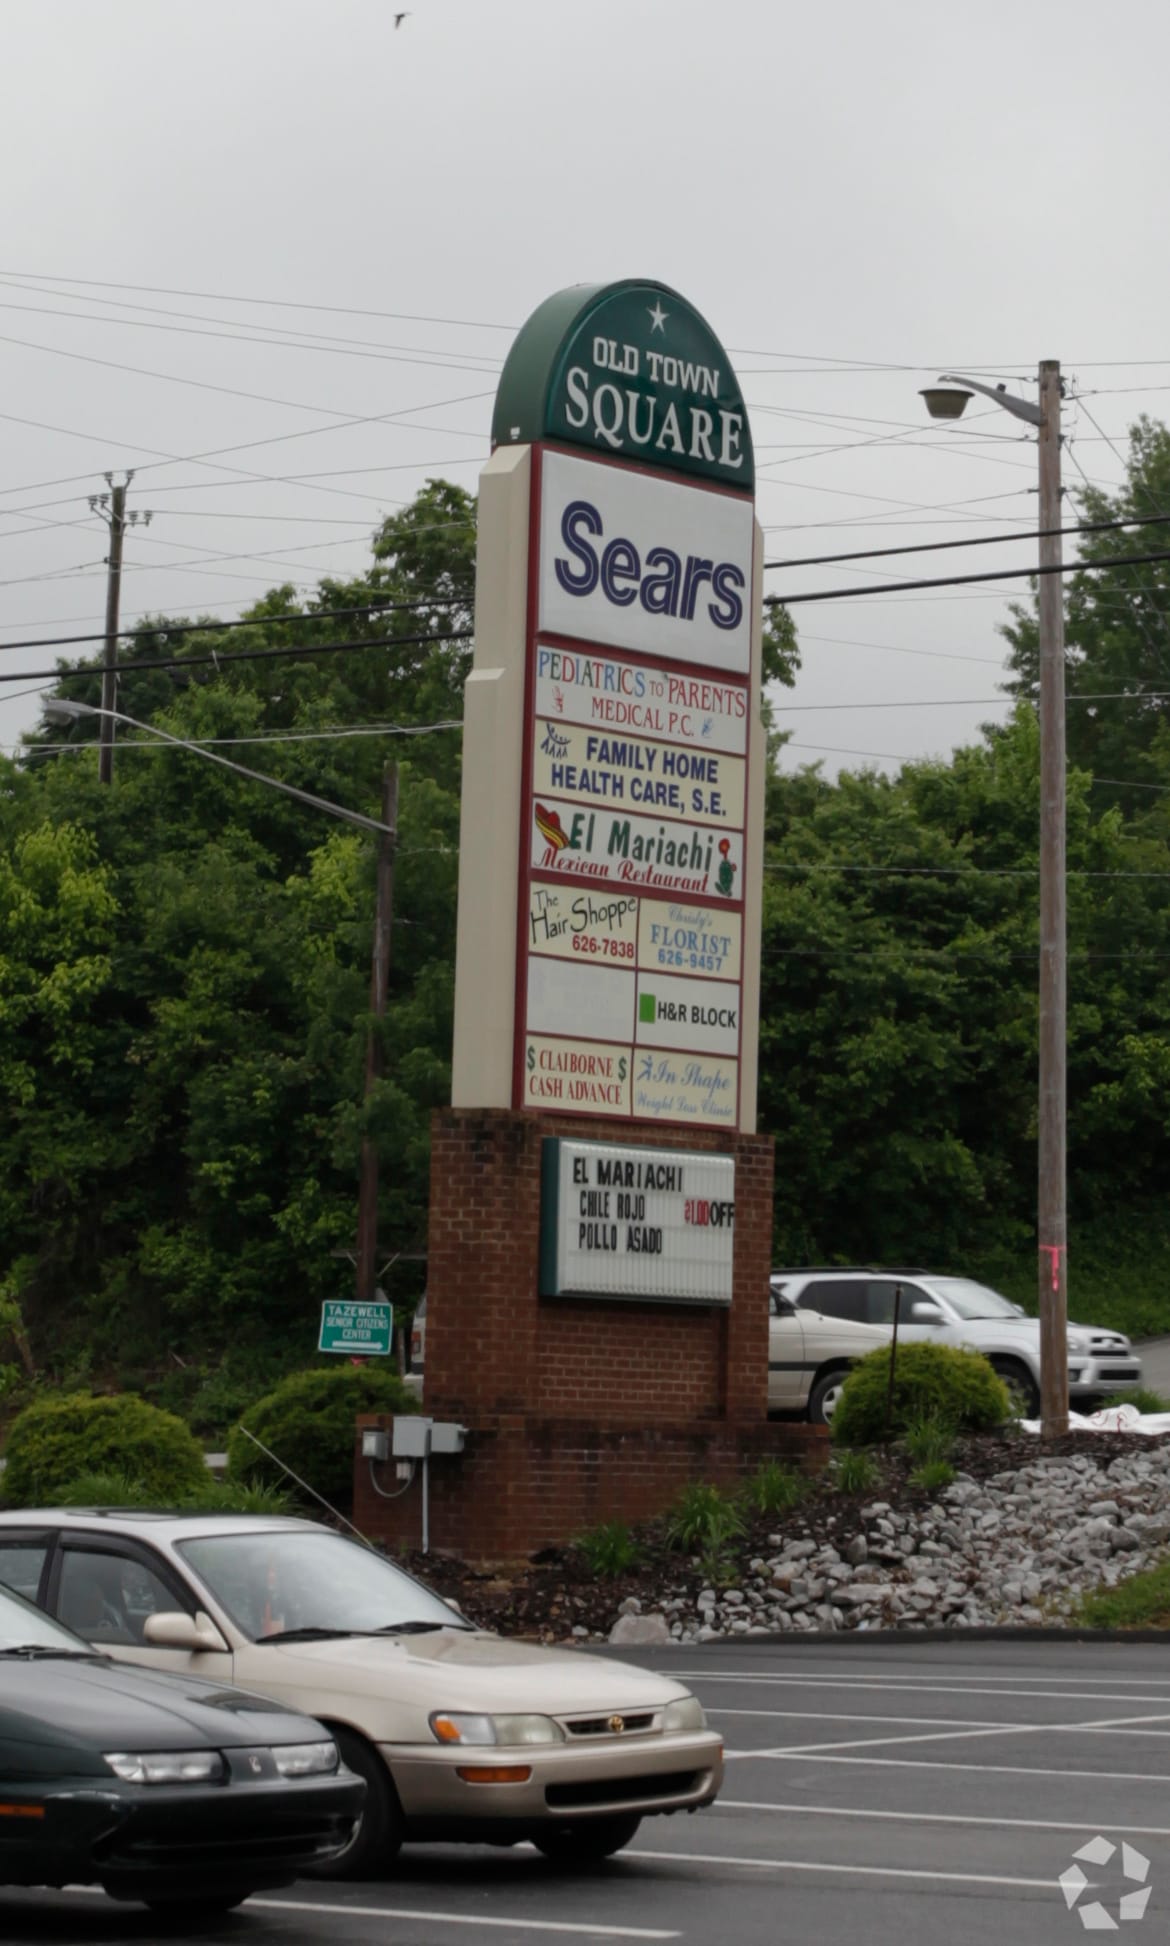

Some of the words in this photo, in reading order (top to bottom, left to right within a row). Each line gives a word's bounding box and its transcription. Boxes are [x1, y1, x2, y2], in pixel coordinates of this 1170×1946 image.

[593, 336, 639, 376] OLD
[646, 350, 719, 399] TOWN
[565, 366, 743, 469] SQUARE
[554, 500, 745, 631] Sears
[538, 650, 645, 698] PEDIATRICS
[667, 677, 746, 718] PARENTS
[591, 697, 663, 731] MEDICAL
[668, 713, 694, 737] P.C.
[586, 736, 656, 772] FAMILY
[662, 752, 718, 784] HOME
[551, 764, 624, 798] HEALTH
[630, 777, 685, 814] CARE,
[692, 789, 727, 816] S.E.
[568, 812, 595, 852] El
[607, 820, 713, 873] Mariachi
[533, 846, 610, 878] Mexican
[617, 861, 709, 893] Restaurant
[533, 889, 559, 911] The
[531, 907, 568, 944] Hair
[570, 896, 637, 933] Shoppe
[572, 935, 635, 959] 626-7838
[650, 924, 731, 957] FLORIST
[658, 948, 723, 972] 626-9457
[657, 1001, 687, 1023] H&R
[691, 1003, 737, 1028] BLOCK
[539, 1050, 613, 1079] CLAIBORNE
[680, 1062, 730, 1098] Shape
[529, 1075, 563, 1100] CASH
[568, 1081, 622, 1105] ADVANCE
[573, 1157, 589, 1184] EL
[597, 1159, 683, 1192] MARIACHI
[580, 1190, 610, 1218] CHILE
[617, 1193, 645, 1221] ROJO
[710, 1201, 736, 1227] OFF
[579, 1223, 617, 1251] POLLO
[627, 1226, 663, 1254] ASADO
[326, 1316, 353, 1327] SENIOR
[356, 1317, 388, 1329] CITIZENS
[328, 1304, 386, 1318] TAZEWELL
[342, 1328, 372, 1340] CENTER
